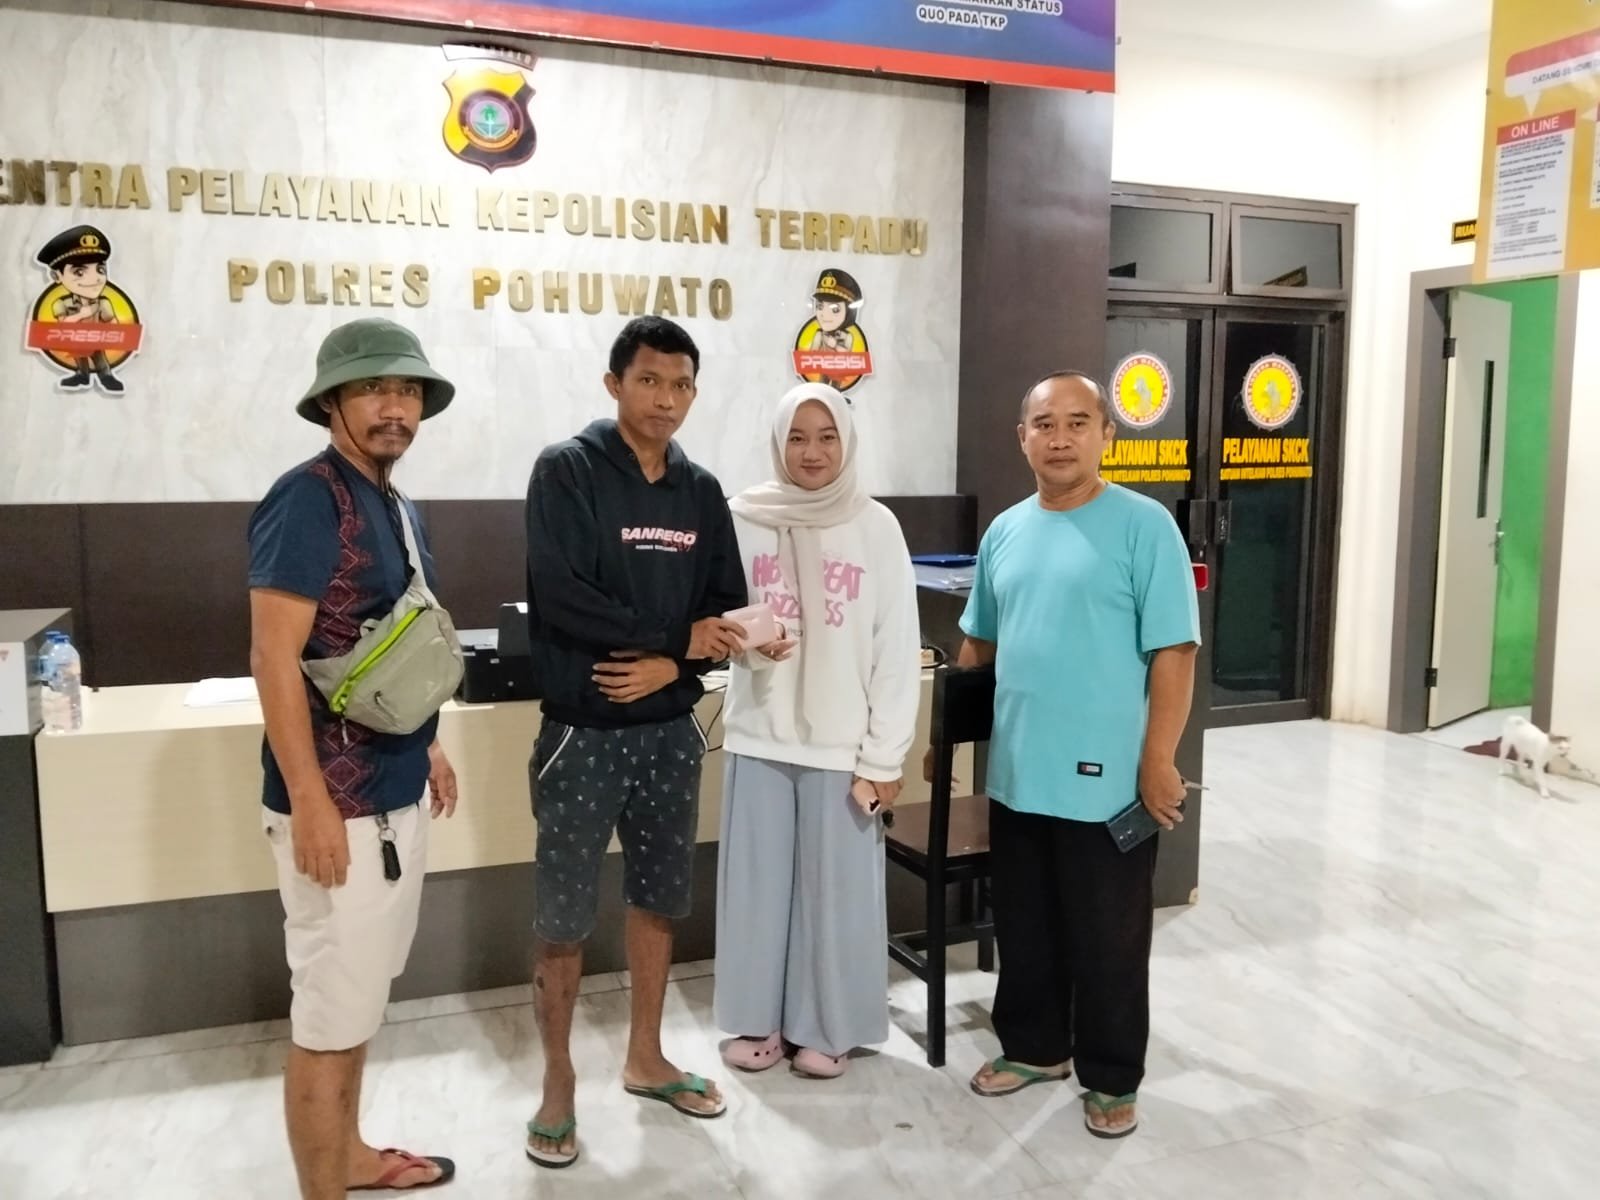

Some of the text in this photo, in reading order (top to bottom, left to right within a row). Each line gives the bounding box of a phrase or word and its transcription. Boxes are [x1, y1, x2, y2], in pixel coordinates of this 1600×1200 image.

[918, 7, 1006, 28] QUO PADA TKP
[1017, 0, 1061, 13] STATUS
[1511, 116, 1559, 138] ON LINE
[167, 167, 450, 228] PELAYANAN
[476, 185, 729, 245] KEPOLISIAN
[754, 208, 928, 257] TERPADU
[227, 259, 733, 321] POLRES POHUWATO
[47, 329, 126, 343] PRESISI
[801, 355, 866, 369] PRESISI
[1158, 439, 1188, 466] SKCK
[1223, 438, 1309, 463] PELAYANAN SKCK
